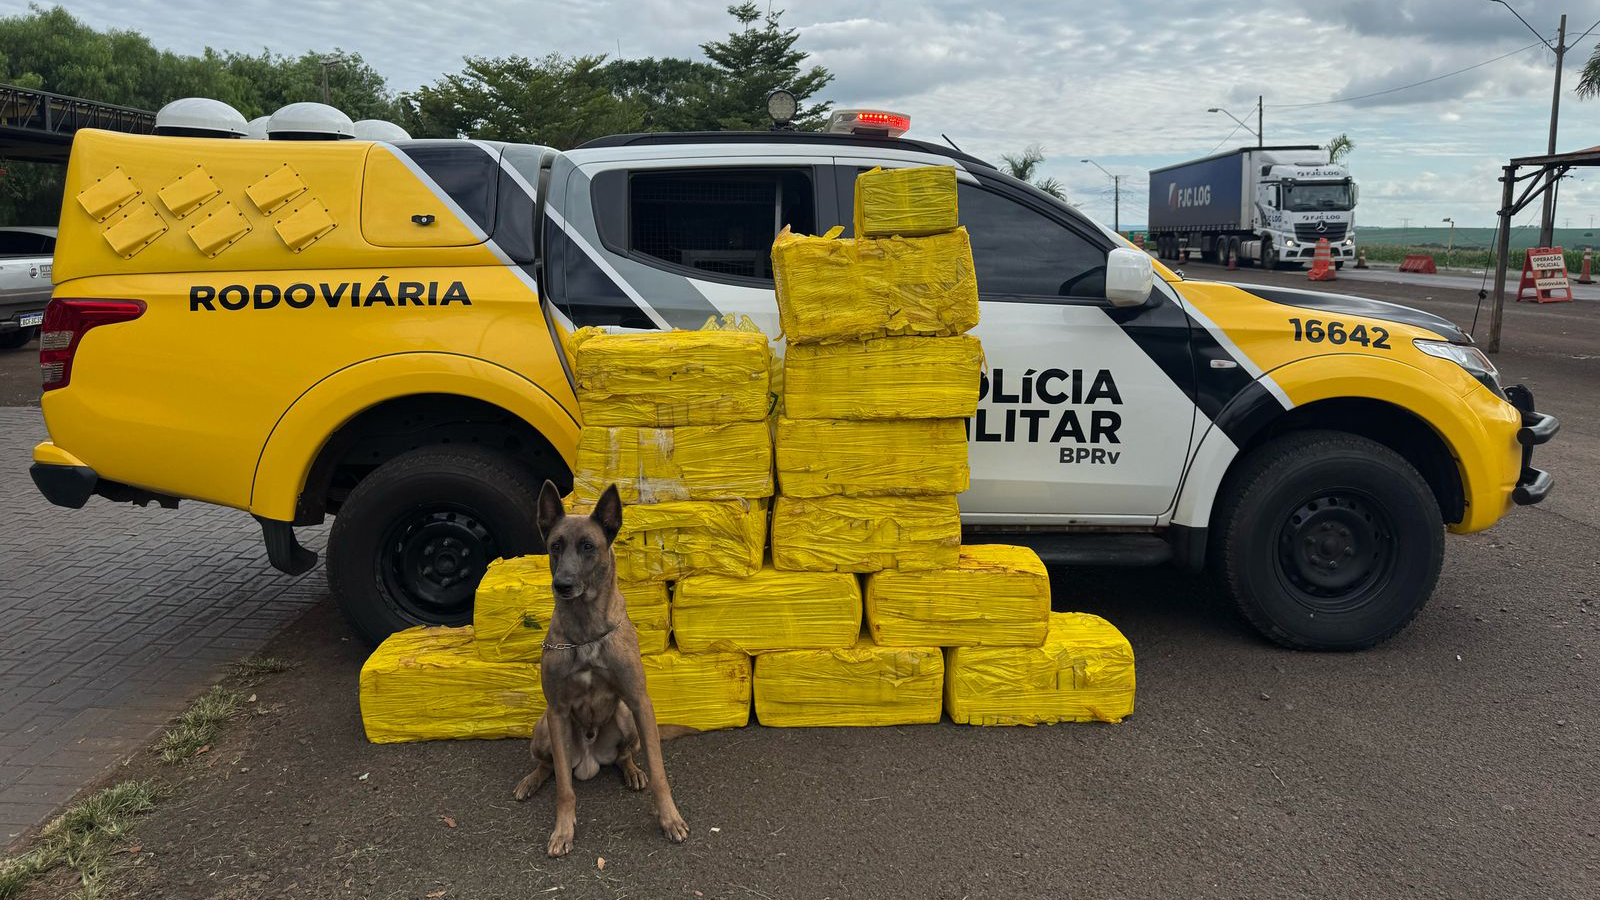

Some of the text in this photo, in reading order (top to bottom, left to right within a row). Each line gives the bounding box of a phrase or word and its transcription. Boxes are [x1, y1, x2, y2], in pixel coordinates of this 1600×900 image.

[1177, 184, 1211, 208] FJC LOG
[189, 275, 472, 311] RODOVIÁRIA
[1288, 318, 1392, 350] 16642
[1059, 447, 1121, 464] BPRv
